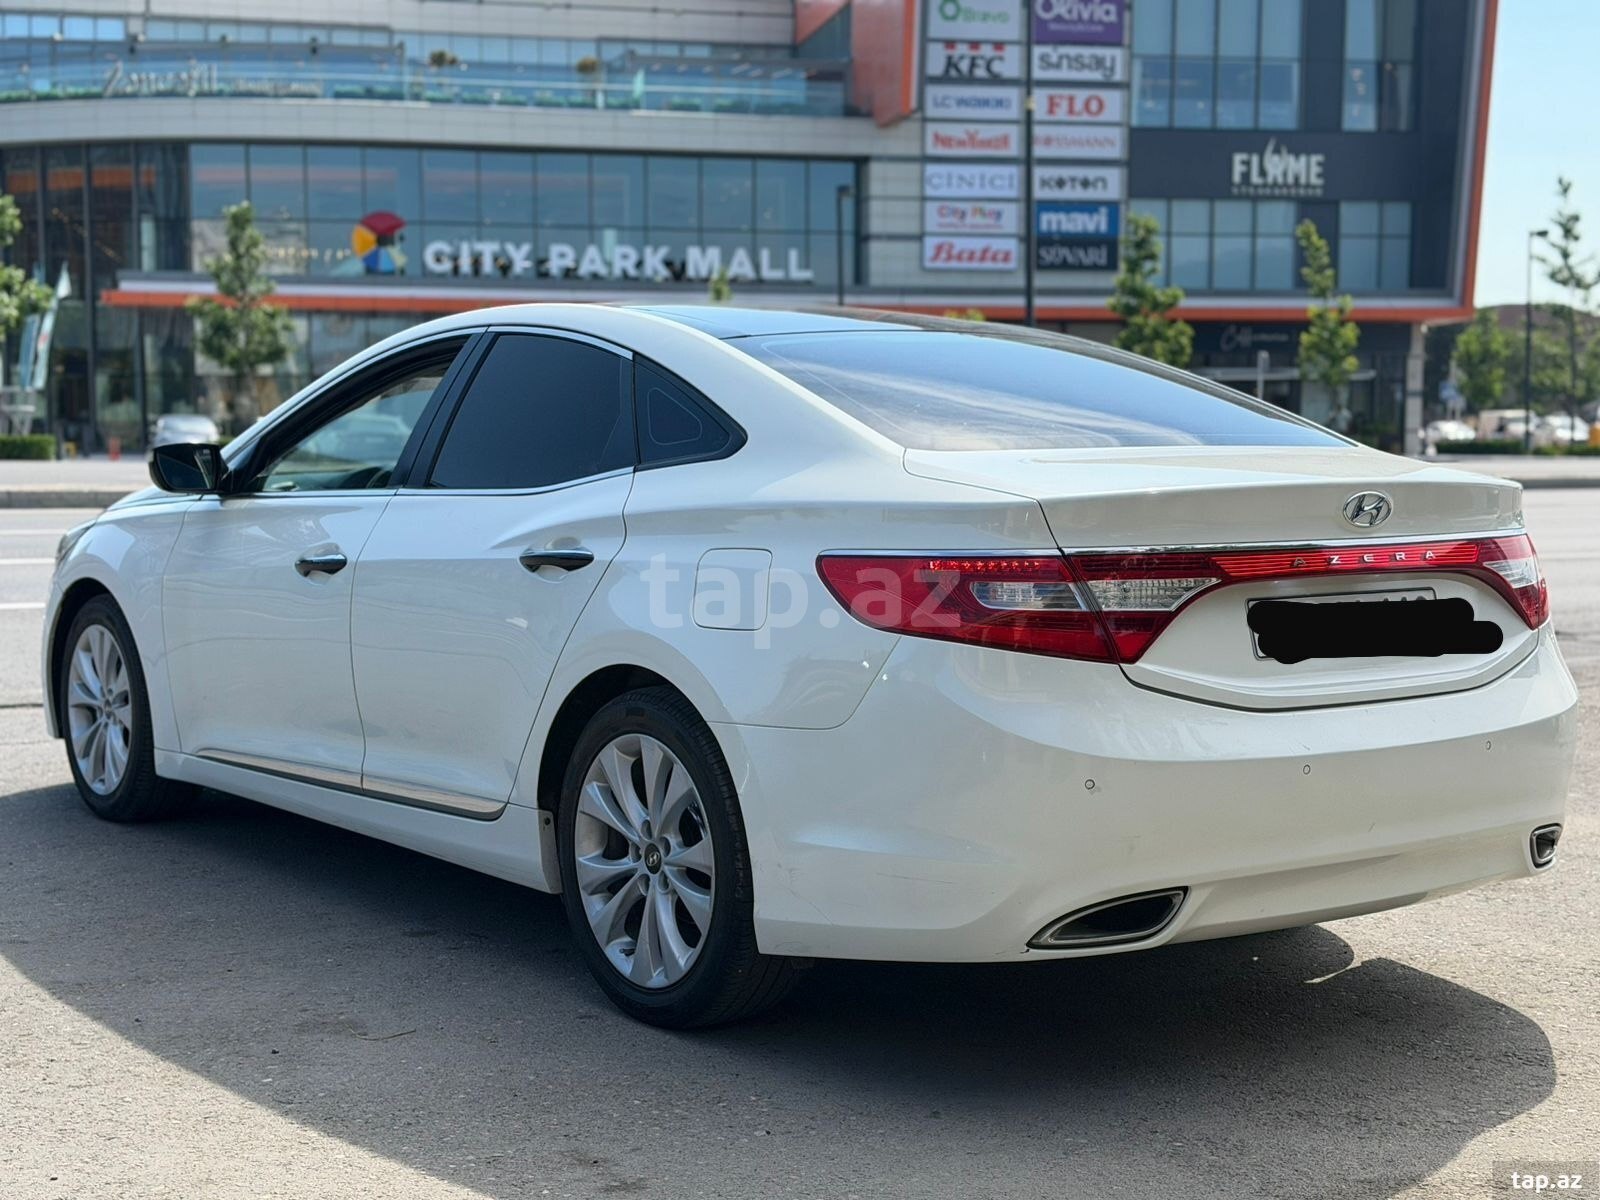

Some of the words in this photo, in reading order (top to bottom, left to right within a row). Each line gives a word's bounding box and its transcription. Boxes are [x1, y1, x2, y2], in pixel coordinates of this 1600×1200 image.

[941, 54, 1005, 79] KFC
[932, 95, 953, 109] LC
[1046, 93, 1105, 117] FLO
[1040, 206, 1108, 234] mavi
[423, 240, 532, 274] CITY
[549, 243, 670, 279] PARK
[687, 245, 813, 281] MALL
[930, 241, 1013, 264] Bata
[1292, 550, 1436, 568] AZERA
